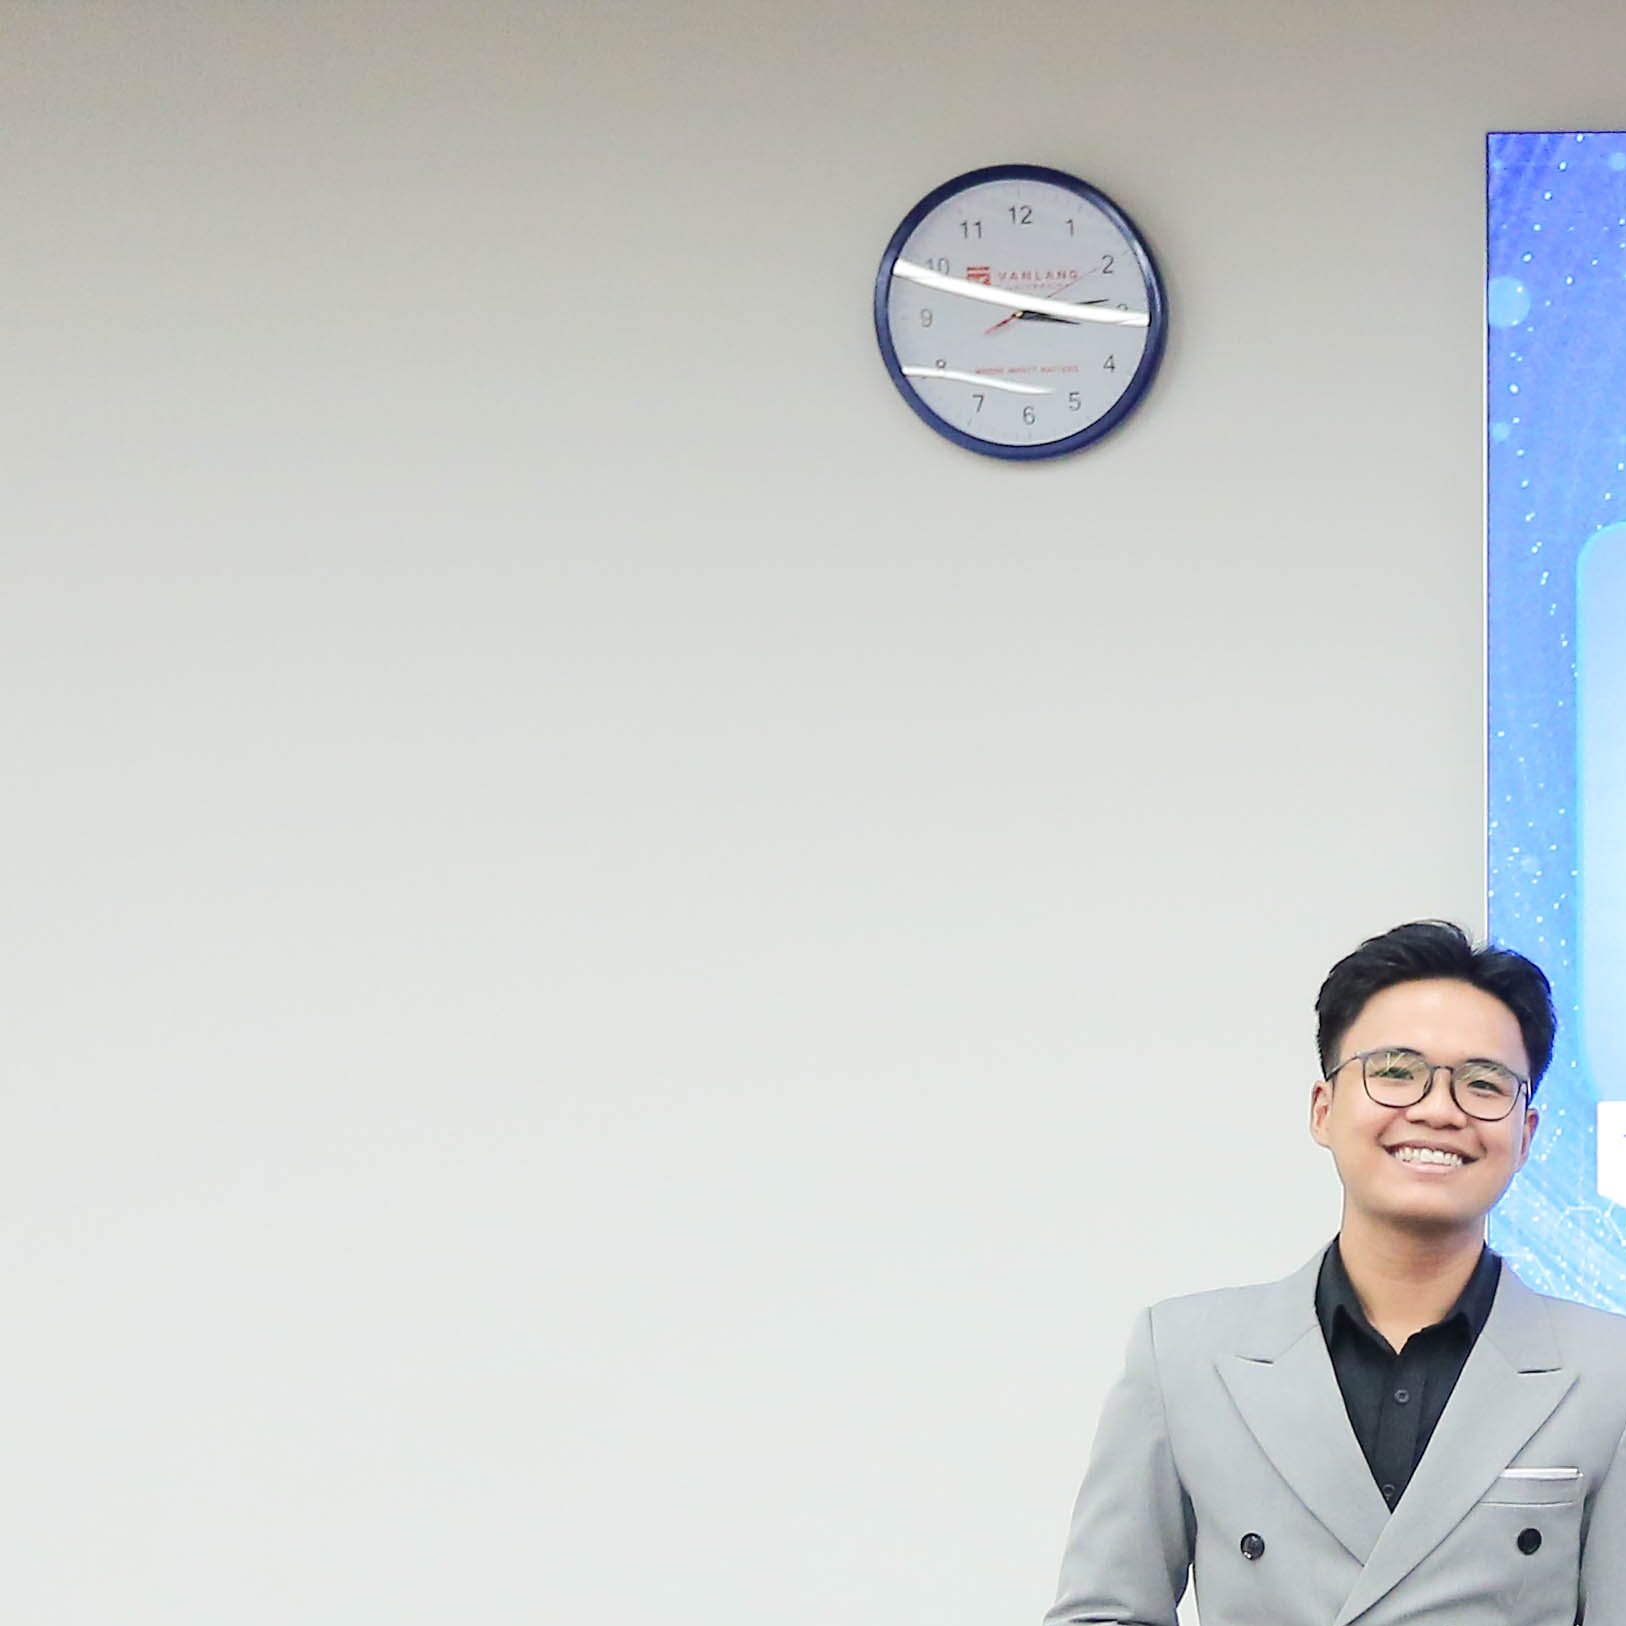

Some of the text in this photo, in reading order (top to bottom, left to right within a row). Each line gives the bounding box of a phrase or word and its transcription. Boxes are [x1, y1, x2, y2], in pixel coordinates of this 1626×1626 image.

[1008, 205, 1033, 225] 12
[960, 220, 983, 239] 11
[1065, 218, 1075, 237] 1
[1101, 254, 1115, 275] 2
[920, 308, 933, 328] 9
[1103, 354, 1115, 373] 4
[972, 394, 985, 413] 7
[1068, 392, 1082, 412] 5
[1023, 406, 1036, 426] 6
